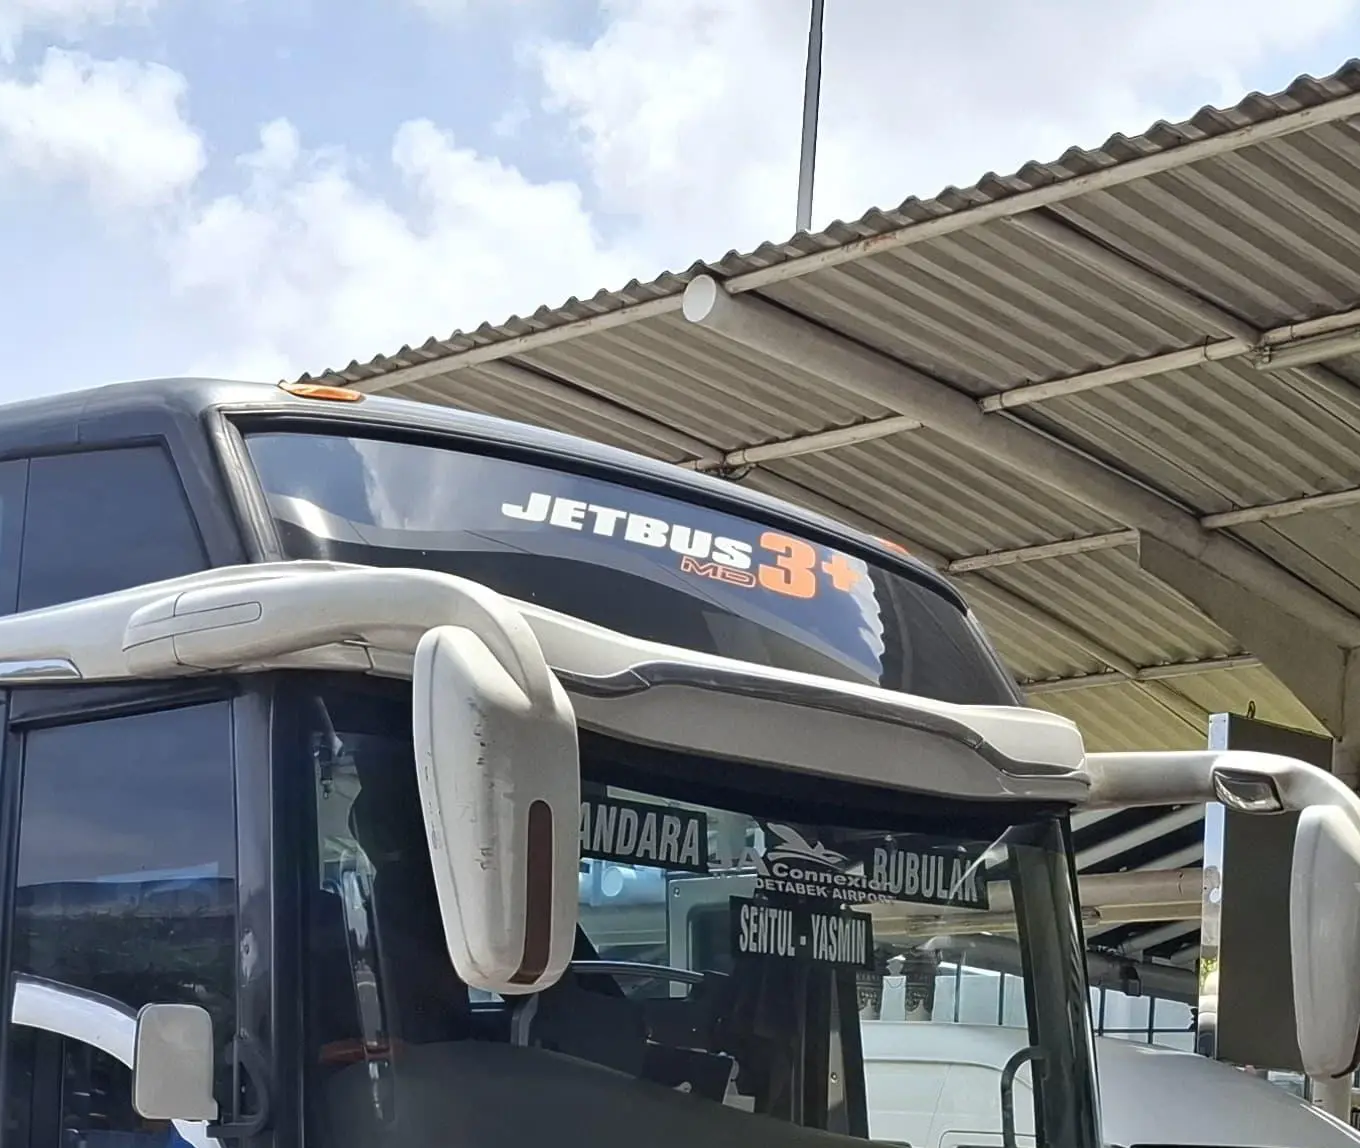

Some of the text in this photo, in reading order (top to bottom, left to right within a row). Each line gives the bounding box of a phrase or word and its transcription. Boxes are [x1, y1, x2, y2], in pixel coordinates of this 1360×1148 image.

[502, 492, 753, 570] JETBUS
[580, 802, 699, 866] ANDARA
[756, 878, 830, 900] DETABEK
[872, 847, 979, 902] BUBULAK
[740, 904, 795, 957] SENTUL
[811, 913, 867, 965] YASMIN
